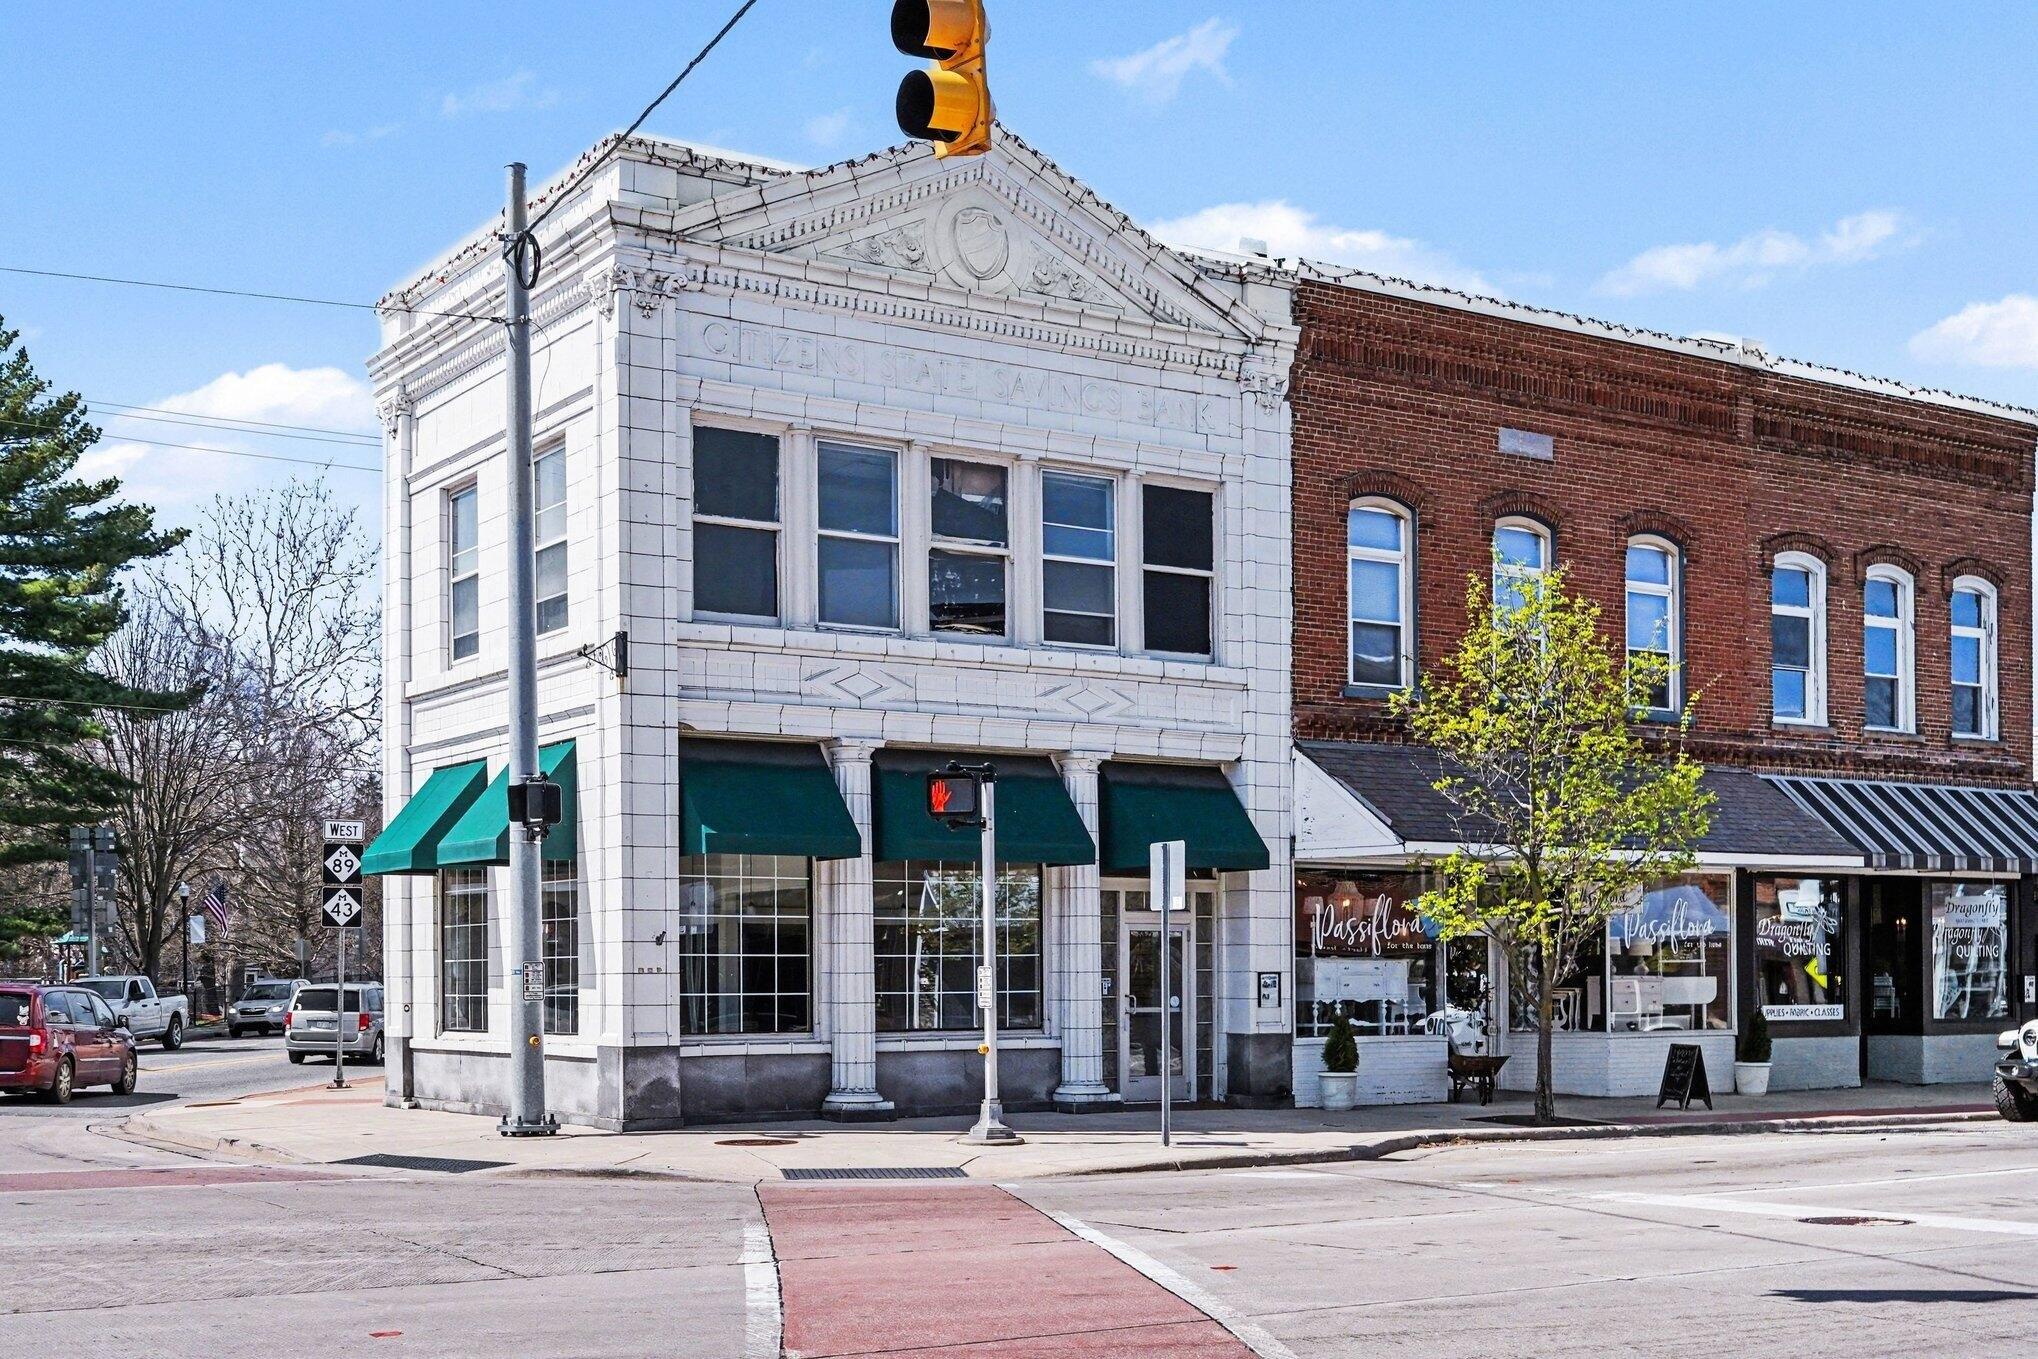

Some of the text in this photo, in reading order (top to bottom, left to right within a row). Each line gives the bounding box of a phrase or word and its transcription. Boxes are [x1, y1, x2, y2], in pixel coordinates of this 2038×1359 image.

[702, 321, 1217, 430] CITIZENS STATE SAVINGS BANK
[329, 823, 359, 837] WEST
[339, 850, 348, 858] M
[332, 858, 354, 873] 89
[338, 894, 347, 902] M
[330, 902, 353, 918] 43
[1945, 899, 1999, 918] Dragonfly
[1315, 893, 1427, 956] Passiflora
[1624, 897, 1717, 955] Passiflora
[1758, 917, 1815, 943] Dragonfly
[1402, 941, 1414, 950] the
[1956, 944, 1999, 959] QUTING
[1814, 1007, 1840, 1017] CLASSES
